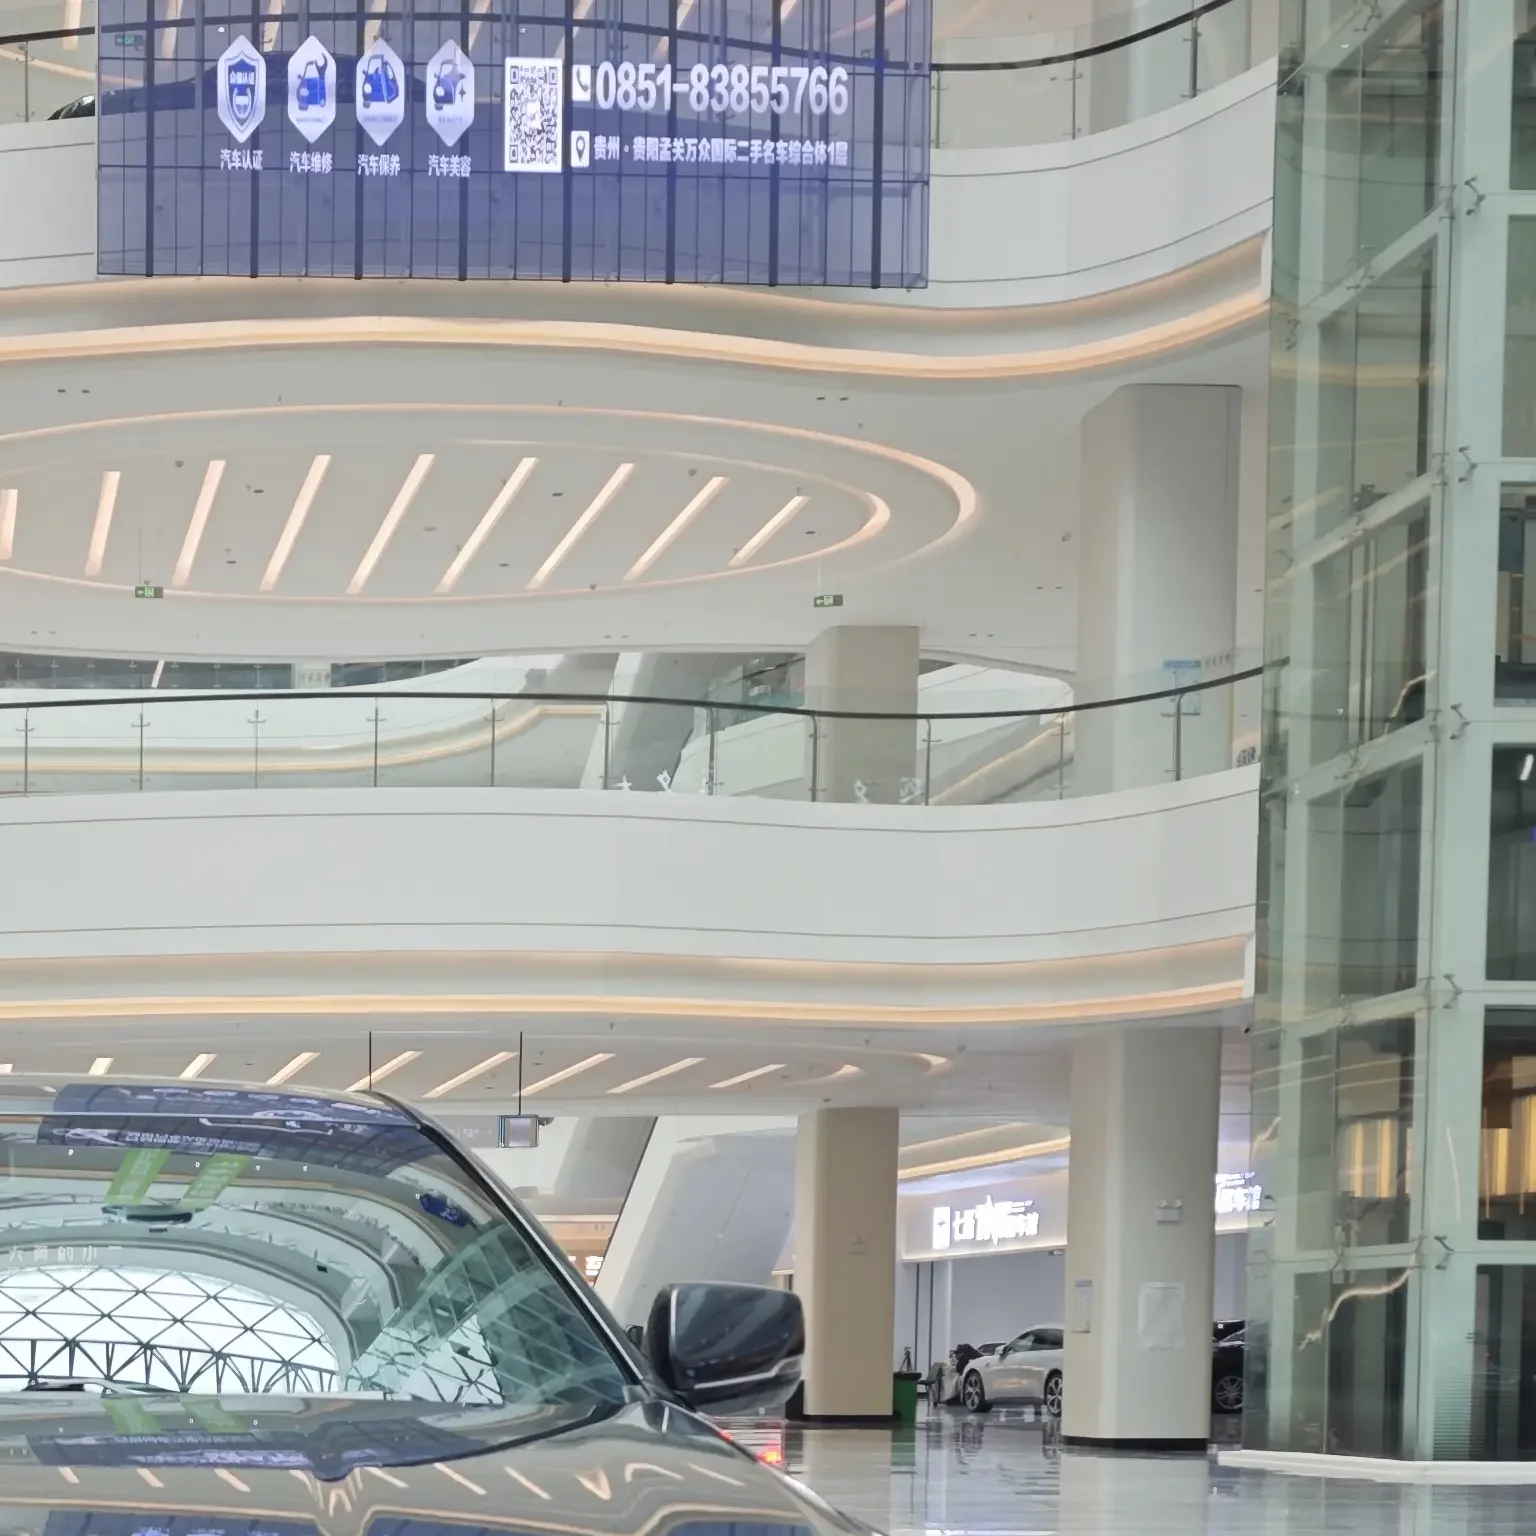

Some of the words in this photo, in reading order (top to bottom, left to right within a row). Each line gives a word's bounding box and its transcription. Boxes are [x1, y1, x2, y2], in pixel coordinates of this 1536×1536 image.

[596, 61, 849, 115] 0851-83855766
[220, 149, 263, 171] 汽车认证
[290, 151, 333, 173] 汽车维修
[358, 154, 401, 176] 汽车保养
[428, 154, 472, 177] 汽车美容
